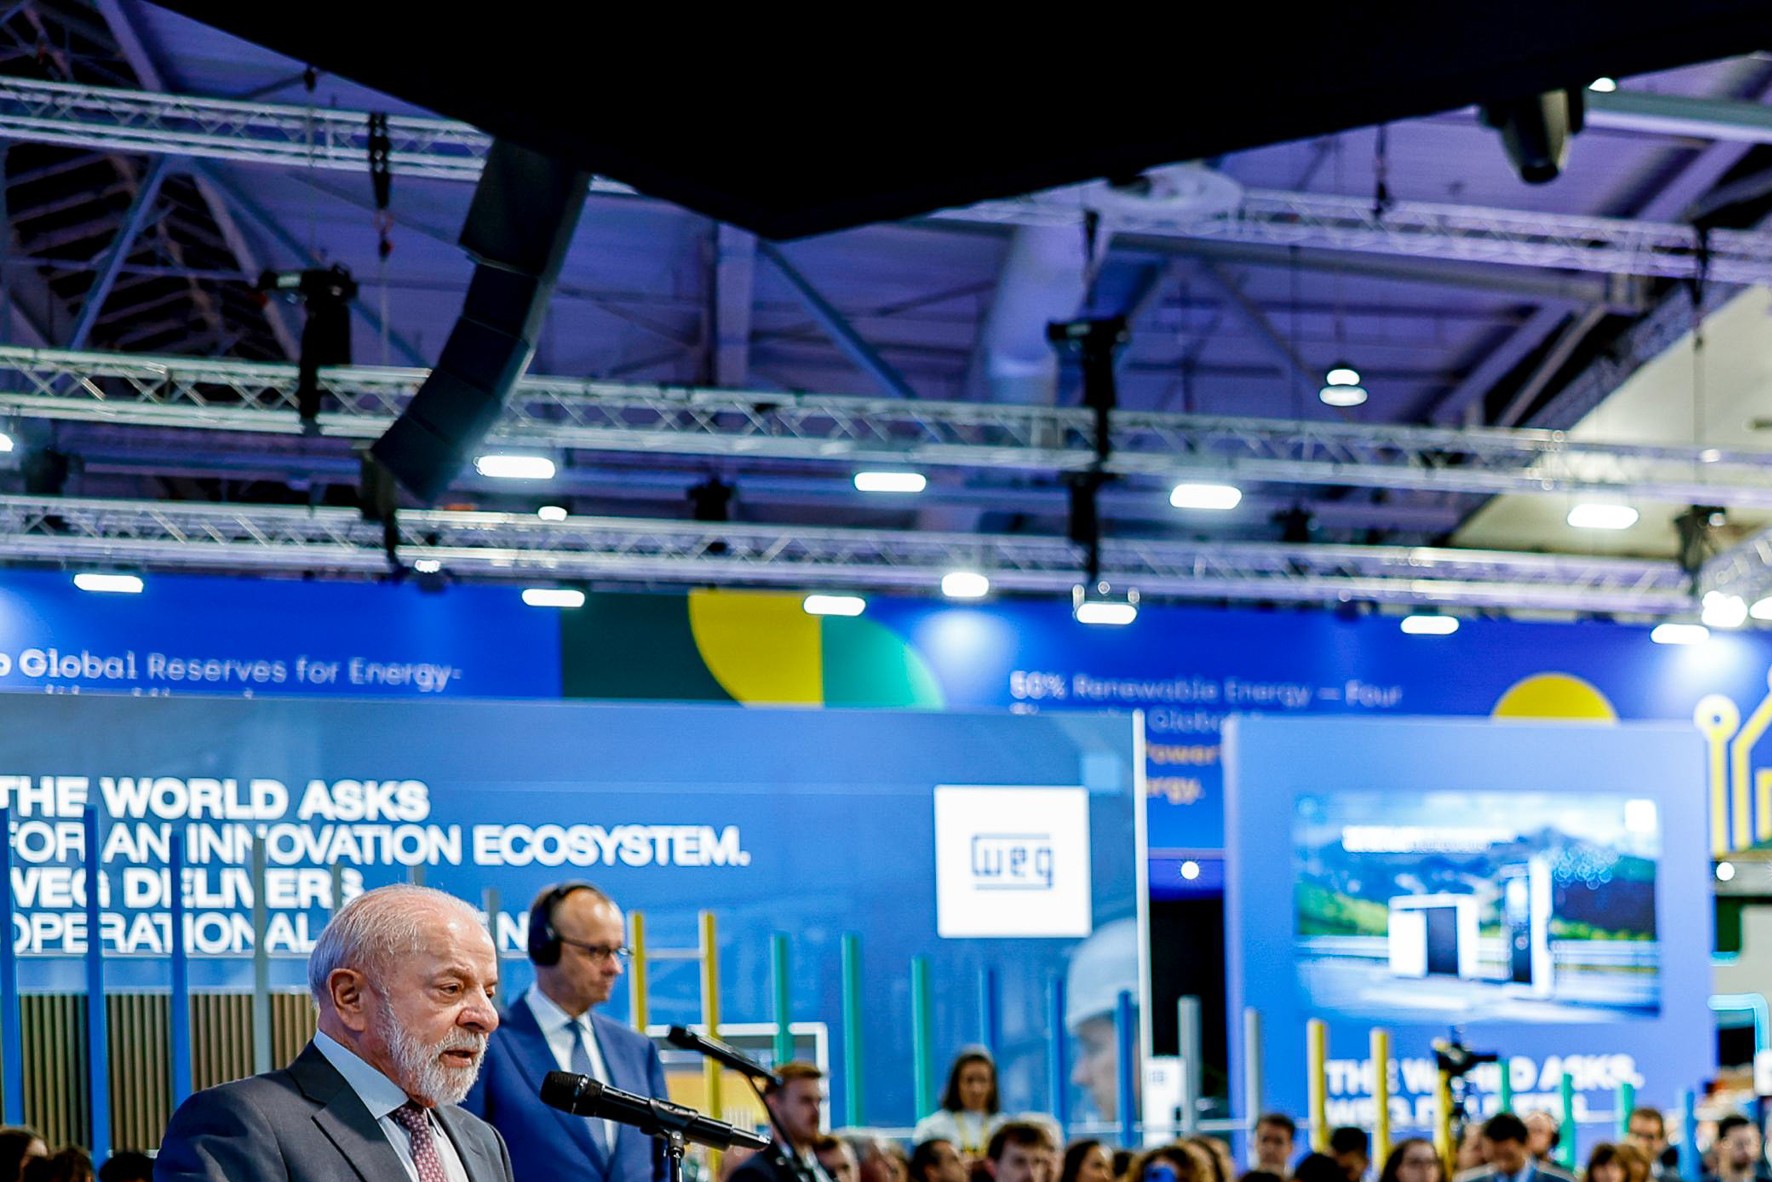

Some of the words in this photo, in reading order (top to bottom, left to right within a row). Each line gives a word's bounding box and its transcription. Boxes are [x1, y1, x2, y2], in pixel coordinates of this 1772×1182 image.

[18, 648, 137, 681] Global
[147, 652, 287, 683] Reserves
[296, 655, 340, 685] for
[349, 656, 462, 692] Energy-
[1073, 673, 1219, 702] Renewable
[1223, 676, 1311, 708] Energy
[0, 775, 89, 818] THE
[100, 776, 289, 820] WORLD
[301, 780, 431, 822] ASKS
[102, 822, 172, 864] AN
[186, 822, 462, 866] INNOVATION
[473, 824, 751, 867] ECOSYSTEM.
